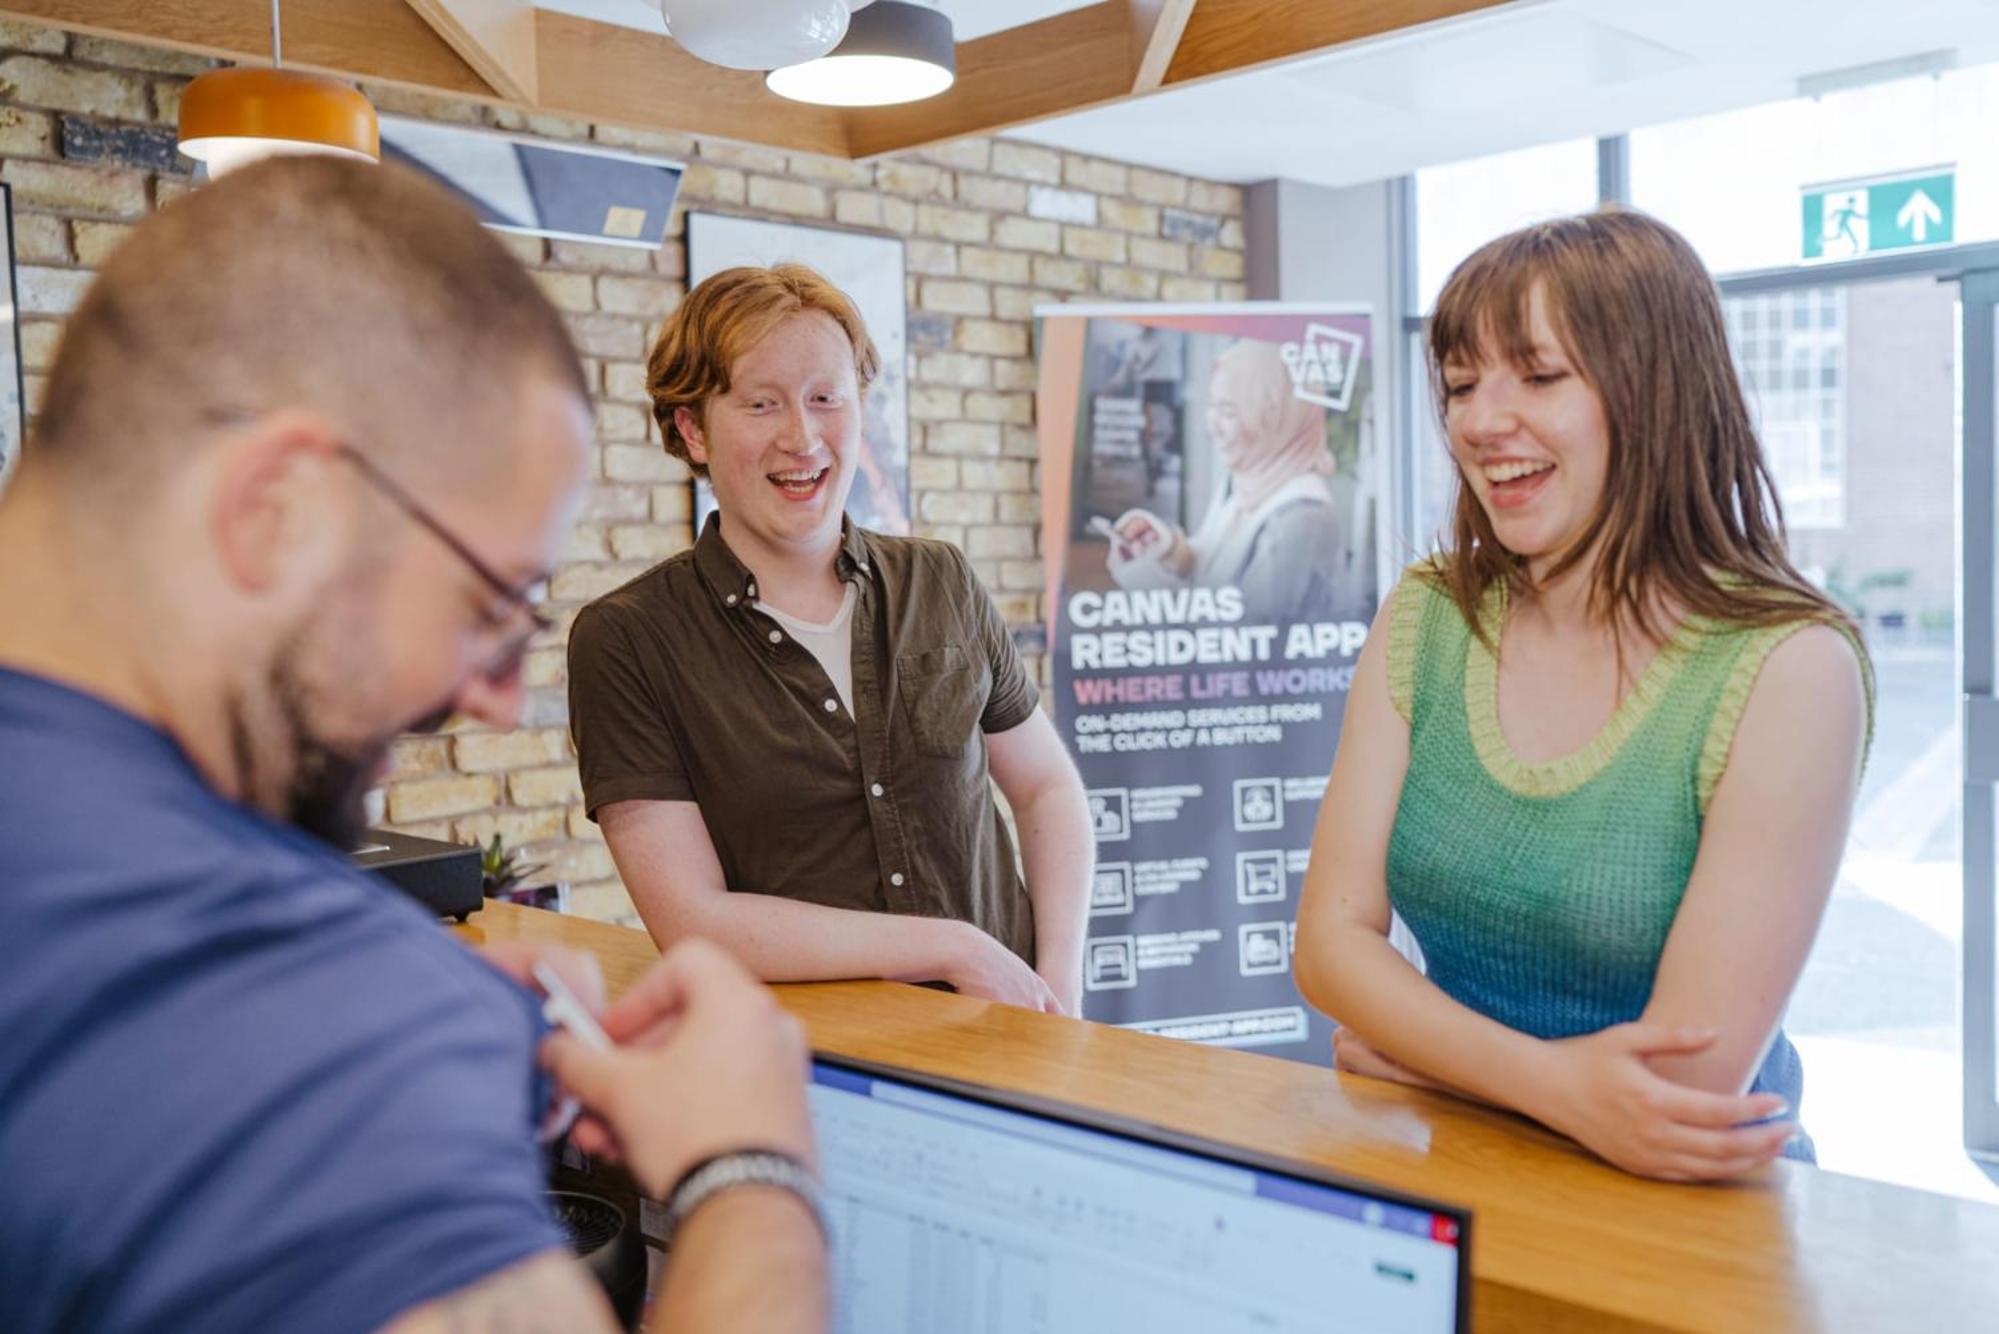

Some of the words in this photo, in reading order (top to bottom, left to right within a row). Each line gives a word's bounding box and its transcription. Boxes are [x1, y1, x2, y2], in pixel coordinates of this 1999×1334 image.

[1280, 342, 1341, 364] CAN
[1287, 363, 1345, 384] VAS
[1069, 588, 1243, 626] CANVAS
[1071, 626, 1277, 669] RESIDENT
[1285, 623, 1368, 658] APP
[1074, 676, 1182, 704] WHERE
[1190, 673, 1249, 698] LIFE
[1075, 710, 1186, 733] ON-DEMAND
[1187, 704, 1270, 727] SERVICES
[1270, 702, 1322, 722] FROM
[1075, 733, 1112, 752] THE
[1113, 731, 1167, 751] CLICK
[1168, 729, 1195, 748] OF
[1196, 728, 1211, 746] A
[1212, 724, 1282, 745] BUTTON
